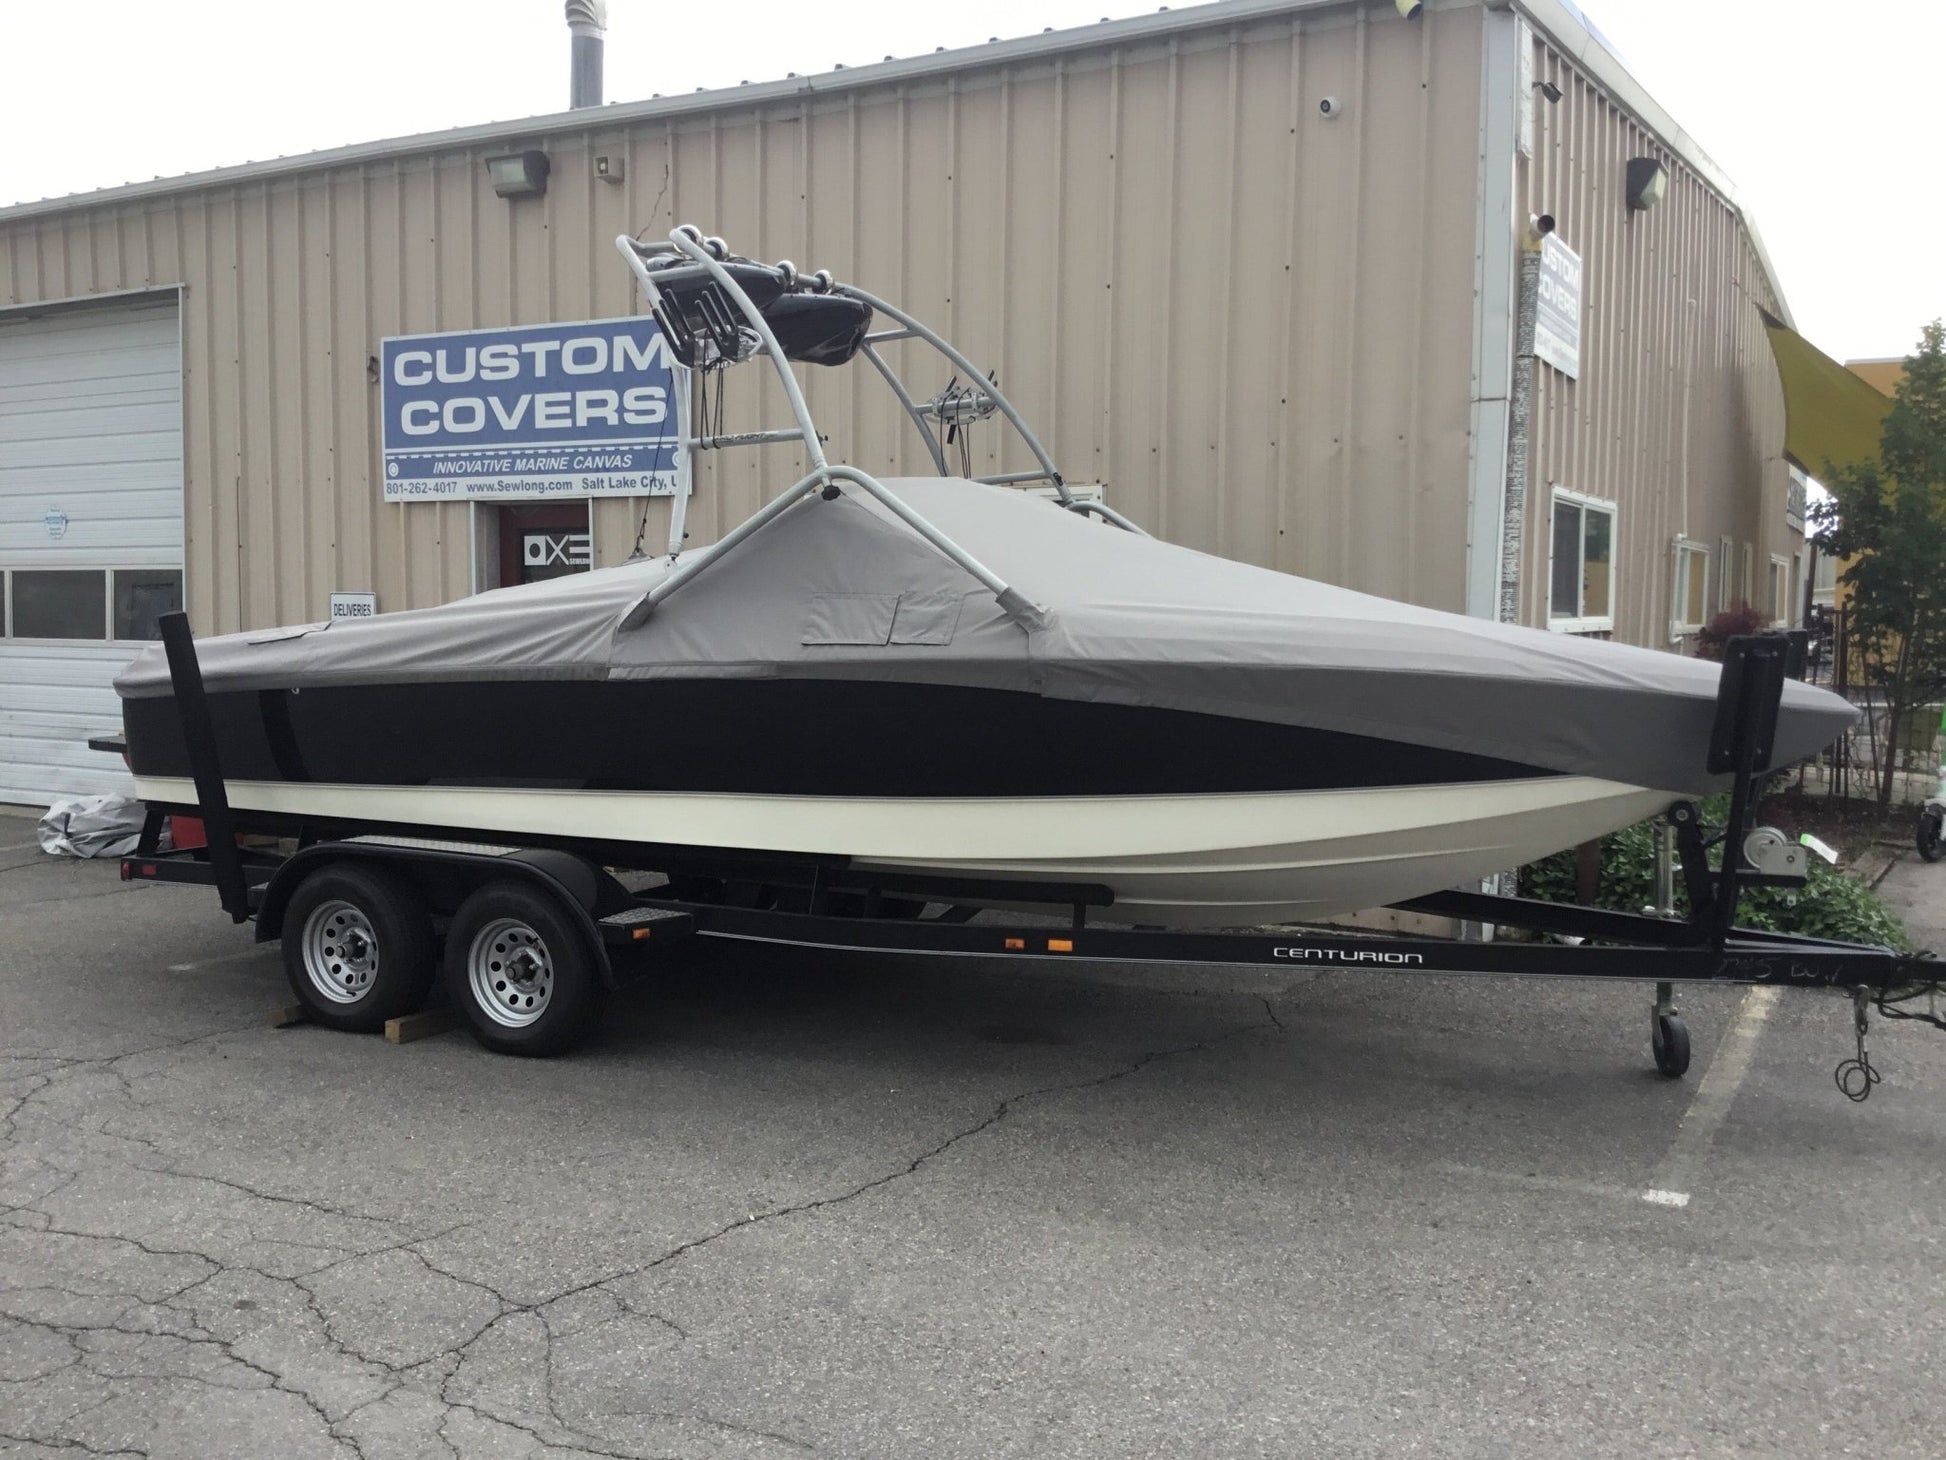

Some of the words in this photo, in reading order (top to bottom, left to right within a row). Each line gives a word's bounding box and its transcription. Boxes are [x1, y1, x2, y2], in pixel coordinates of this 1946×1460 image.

[1542, 242, 1579, 291] USTOM
[394, 333, 671, 386] CUSTOM
[401, 386, 667, 435] COVERS
[433, 459, 513, 474] INNOVATIVE
[514, 456, 569, 471] MARINE
[573, 454, 633, 469] CANVAS
[386, 481, 458, 494] 801-262-4017
[466, 479, 573, 494] www.Sewlong.com
[582, 476, 605, 490] Salt
[608, 476, 637, 490] Lake
[641, 474, 667, 491] City,
[333, 603, 372, 616] DELIVERIES
[1273, 947, 1423, 964] CENTURION
